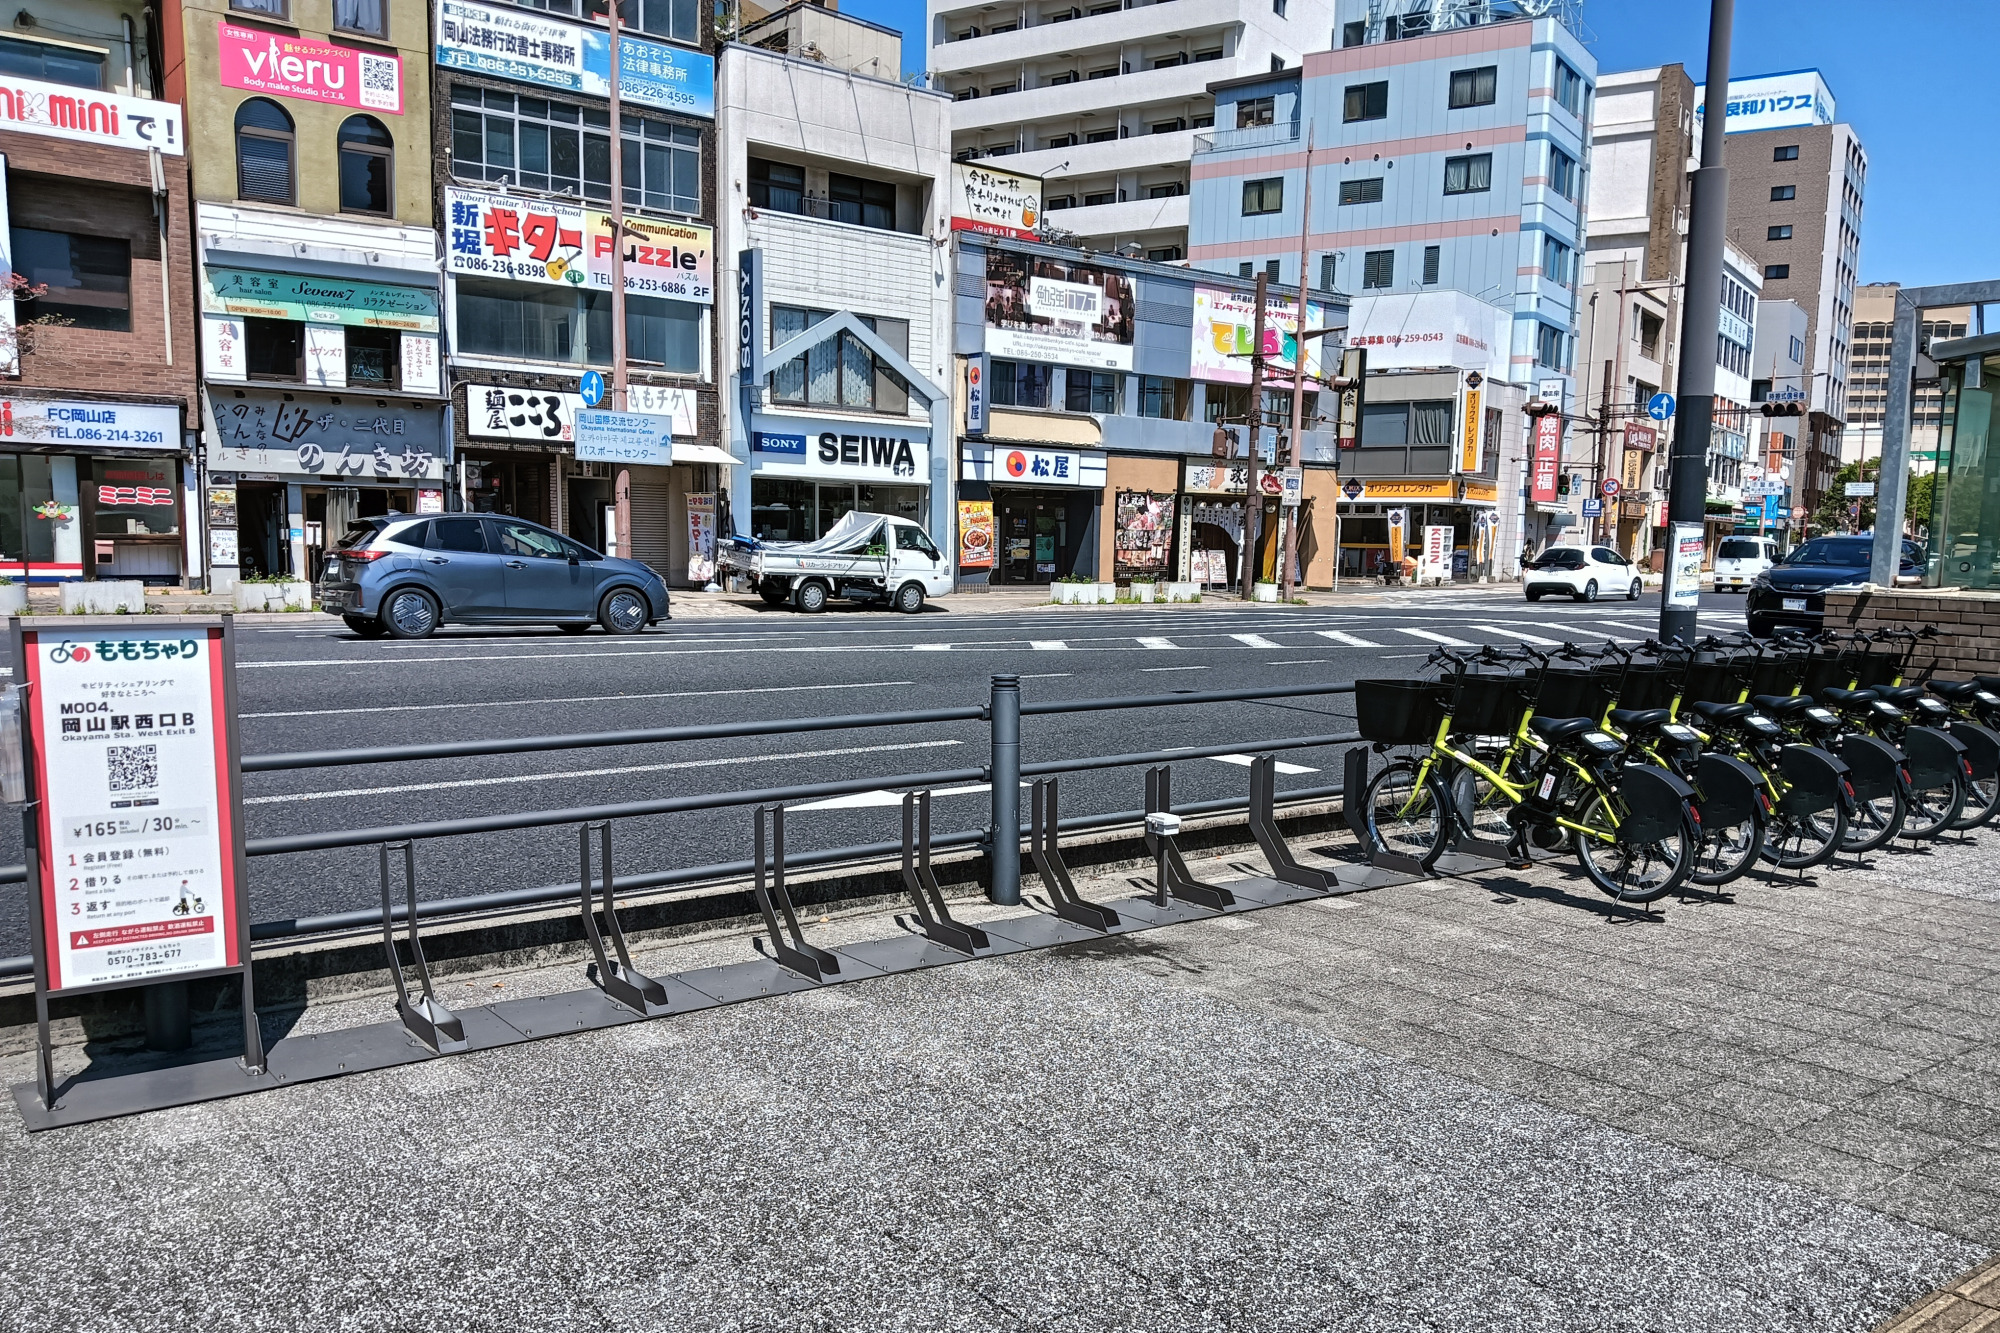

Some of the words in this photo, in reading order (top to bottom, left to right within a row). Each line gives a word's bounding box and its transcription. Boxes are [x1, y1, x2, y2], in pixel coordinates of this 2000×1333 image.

[284, 43, 351, 59] 魅せるカラダづくり
[444, 20, 576, 67] 岡山法務行政書士事務所
[623, 41, 673, 64] あおぞら
[623, 56, 687, 83] 法律事務所
[243, 76, 266, 88] Body
[267, 82, 291, 93] make
[291, 84, 319, 97] Studio
[322, 90, 346, 101] ビエル
[618, 80, 695, 106] 086-226-4595
[1726, 94, 1812, 118] 良和ハウス
[969, 169, 1020, 192] 今日も一杯
[451, 190, 488, 204] Niibori
[488, 195, 520, 209] Guitar
[522, 200, 549, 214] Music
[551, 205, 583, 218] School
[965, 184, 1022, 208] 終わりよければ
[973, 203, 1012, 220] すべてよし
[483, 207, 583, 263] ギター
[625, 219, 698, 241] Communication
[466, 256, 546, 279] 086-236-8398
[567, 270, 583, 284] 3F
[677, 272, 700, 282] パズル
[233, 275, 279, 290] 美容室
[239, 286, 253, 294] hair
[254, 288, 272, 296] salon
[623, 276, 687, 295] 86-253-6886
[693, 286, 709, 298] 2F
[231, 305, 248, 313] OPEN
[364, 296, 428, 312] リラクゼーション
[740, 268, 751, 370] SONY
[217, 322, 234, 369] 美容室
[1350, 335, 1385, 346] 広告募集
[1386, 332, 1444, 344] 086-259-0543
[969, 387, 981, 420] 松屋
[1469, 392, 1477, 424] オリックス
[507, 393, 562, 437] こころ
[579, 413, 657, 428] 岡山国際交流センター
[214, 402, 228, 462] ハイボール
[232, 404, 250, 461] のんき
[580, 424, 605, 432] Okayama
[606, 426, 637, 434] International
[1538, 416, 1558, 453] 焼肉
[761, 437, 800, 450] SONY
[818, 432, 916, 468] SEIWA
[1466, 425, 1475, 458] レンタカー
[296, 442, 434, 477] のんき坊
[579, 445, 657, 459] パスポートセンター
[892, 464, 916, 477] セイワ
[1031, 454, 1070, 479] 松屋
[1536, 456, 1555, 491] 正福
[99, 486, 174, 505] ミニミニ
[1367, 484, 1401, 493] オリックス
[1403, 484, 1439, 493] レンタカー
[1587, 501, 1595, 509] P
[1430, 527, 1442, 564] KIRIN
[94, 639, 200, 663] ももちゃり
[81, 679, 175, 690] モビリティシェアリングで
[101, 690, 156, 699] 好きなところへ
[61, 733, 111, 742] Okayama
[166, 728, 186, 736] Exit
[189, 727, 196, 735] B
[152, 816, 173, 832] 30
[68, 854, 77, 867] 1
[69, 878, 80, 891] 2
[85, 875, 122, 888] 借りる
[71, 902, 81, 916] 3
[86, 900, 111, 913] 返す
[87, 912, 106, 920] Return
[93, 929, 119, 939] 左側走行
[121, 925, 165, 936] ながら運転禁止
[167, 920, 205, 931] 飲酒運転禁止
[107, 949, 182, 966] 0570-783-677
